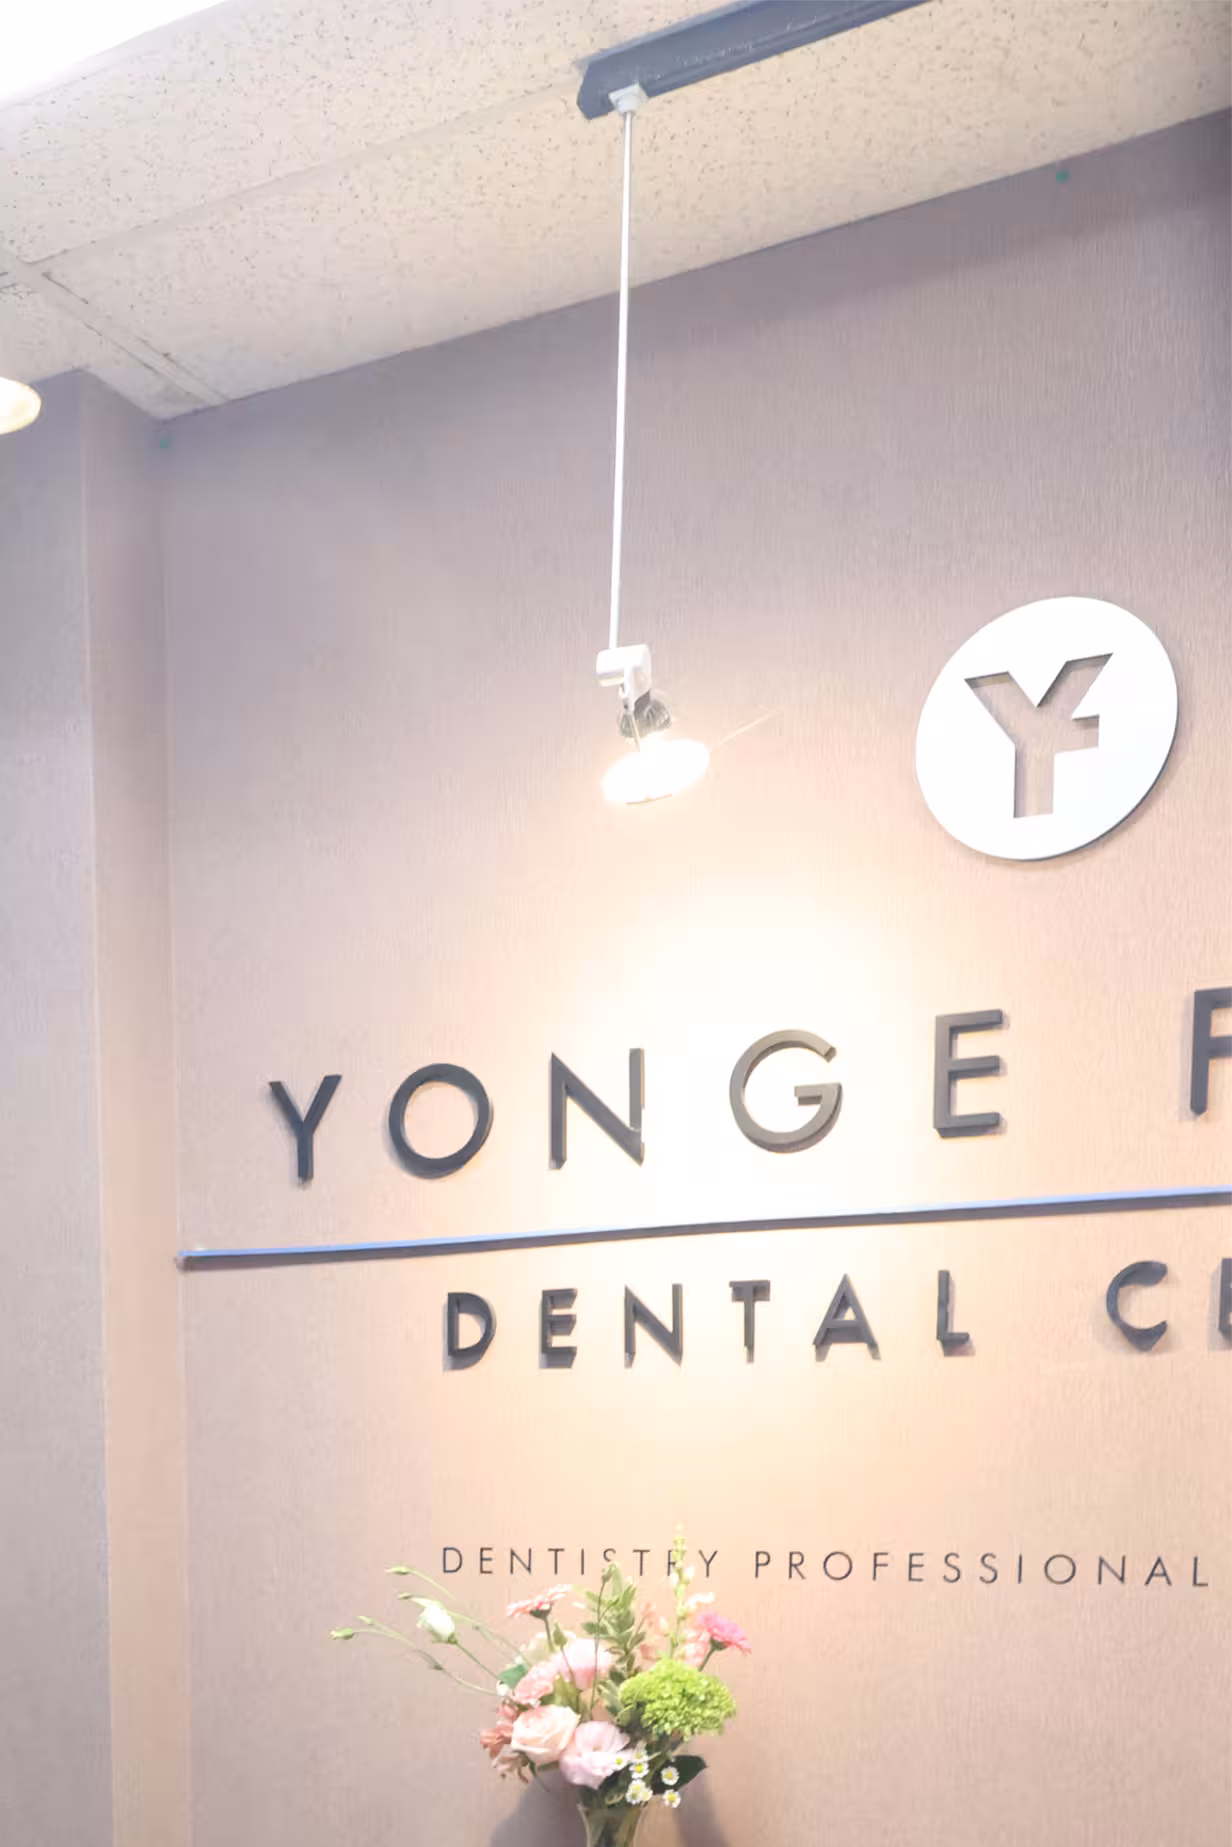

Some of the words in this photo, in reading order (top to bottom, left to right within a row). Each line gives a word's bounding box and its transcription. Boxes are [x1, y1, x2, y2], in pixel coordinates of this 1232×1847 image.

[268, 1009, 1006, 1186] YONGE
[445, 1269, 973, 1370] DENTAL
[754, 1549, 1210, 1588] PROFESSIONAL
